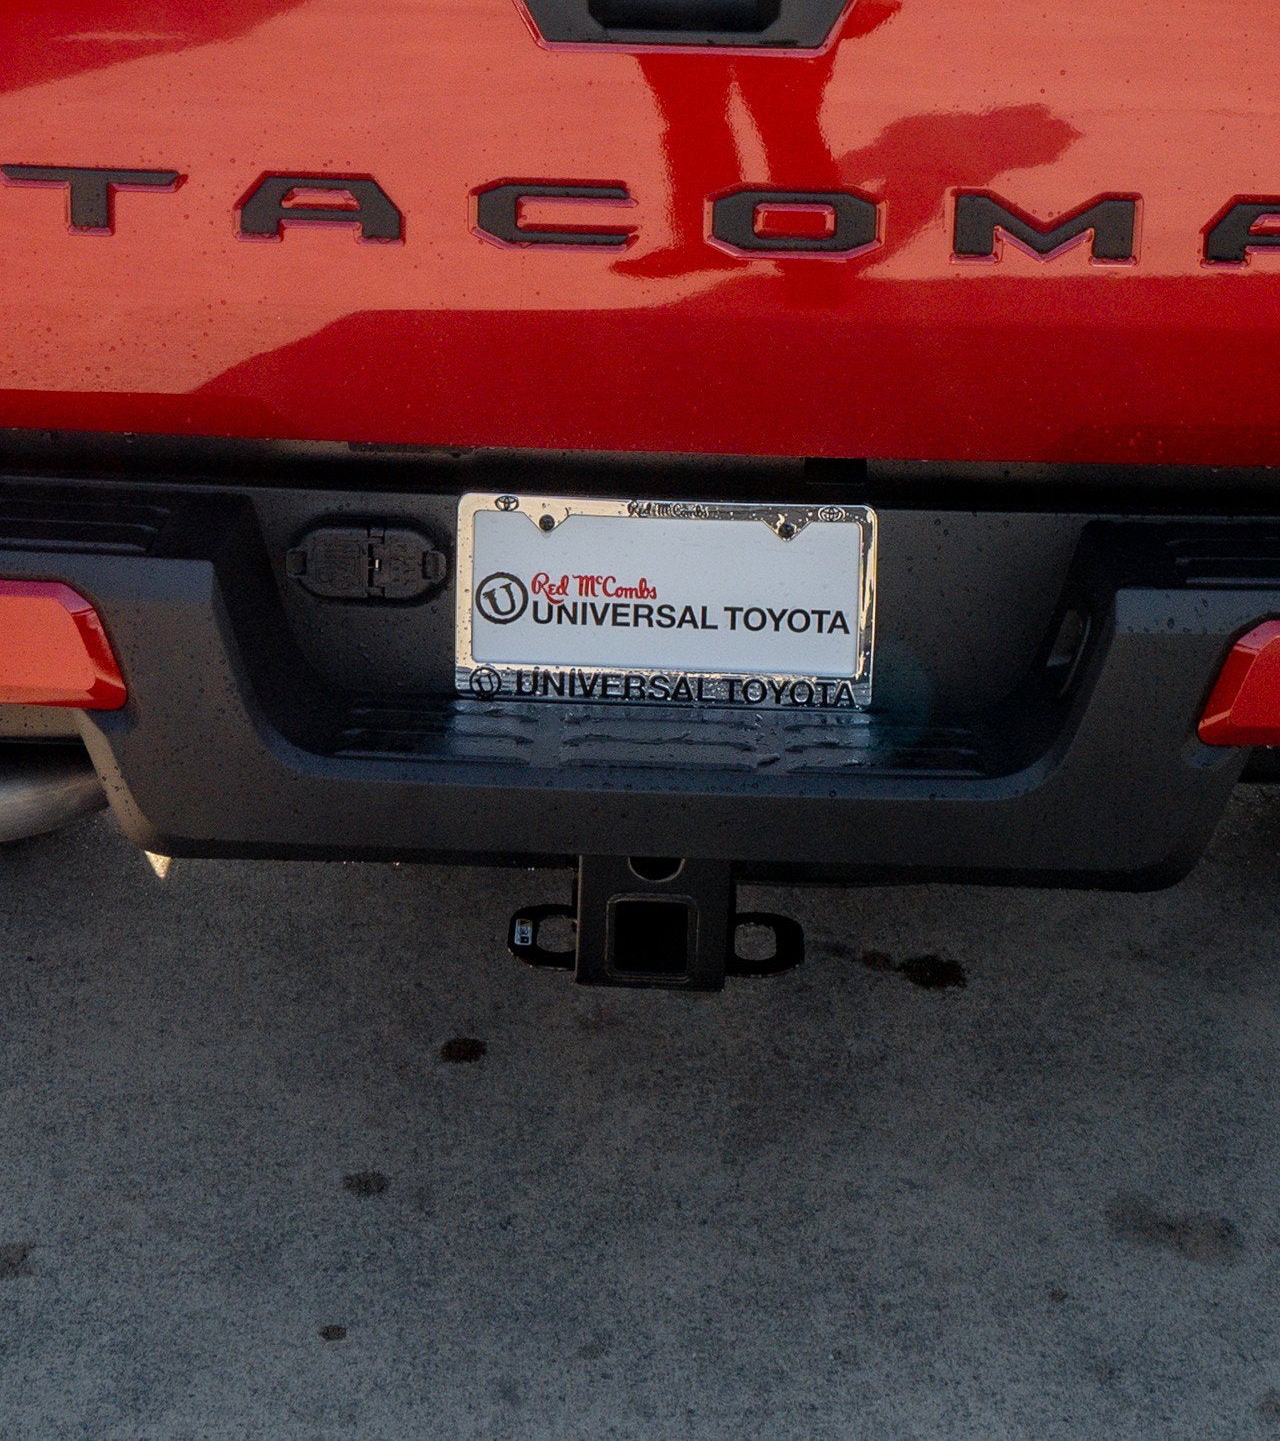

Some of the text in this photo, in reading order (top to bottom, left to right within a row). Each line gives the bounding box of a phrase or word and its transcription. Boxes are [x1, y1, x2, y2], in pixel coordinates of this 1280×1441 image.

[531, 572, 657, 604] Red McCombs
[532, 600, 851, 635] UNIVERSAL TOYOTA
[516, 668, 716, 703] UNIVERSAL
[724, 677, 857, 708] TOYOTA
